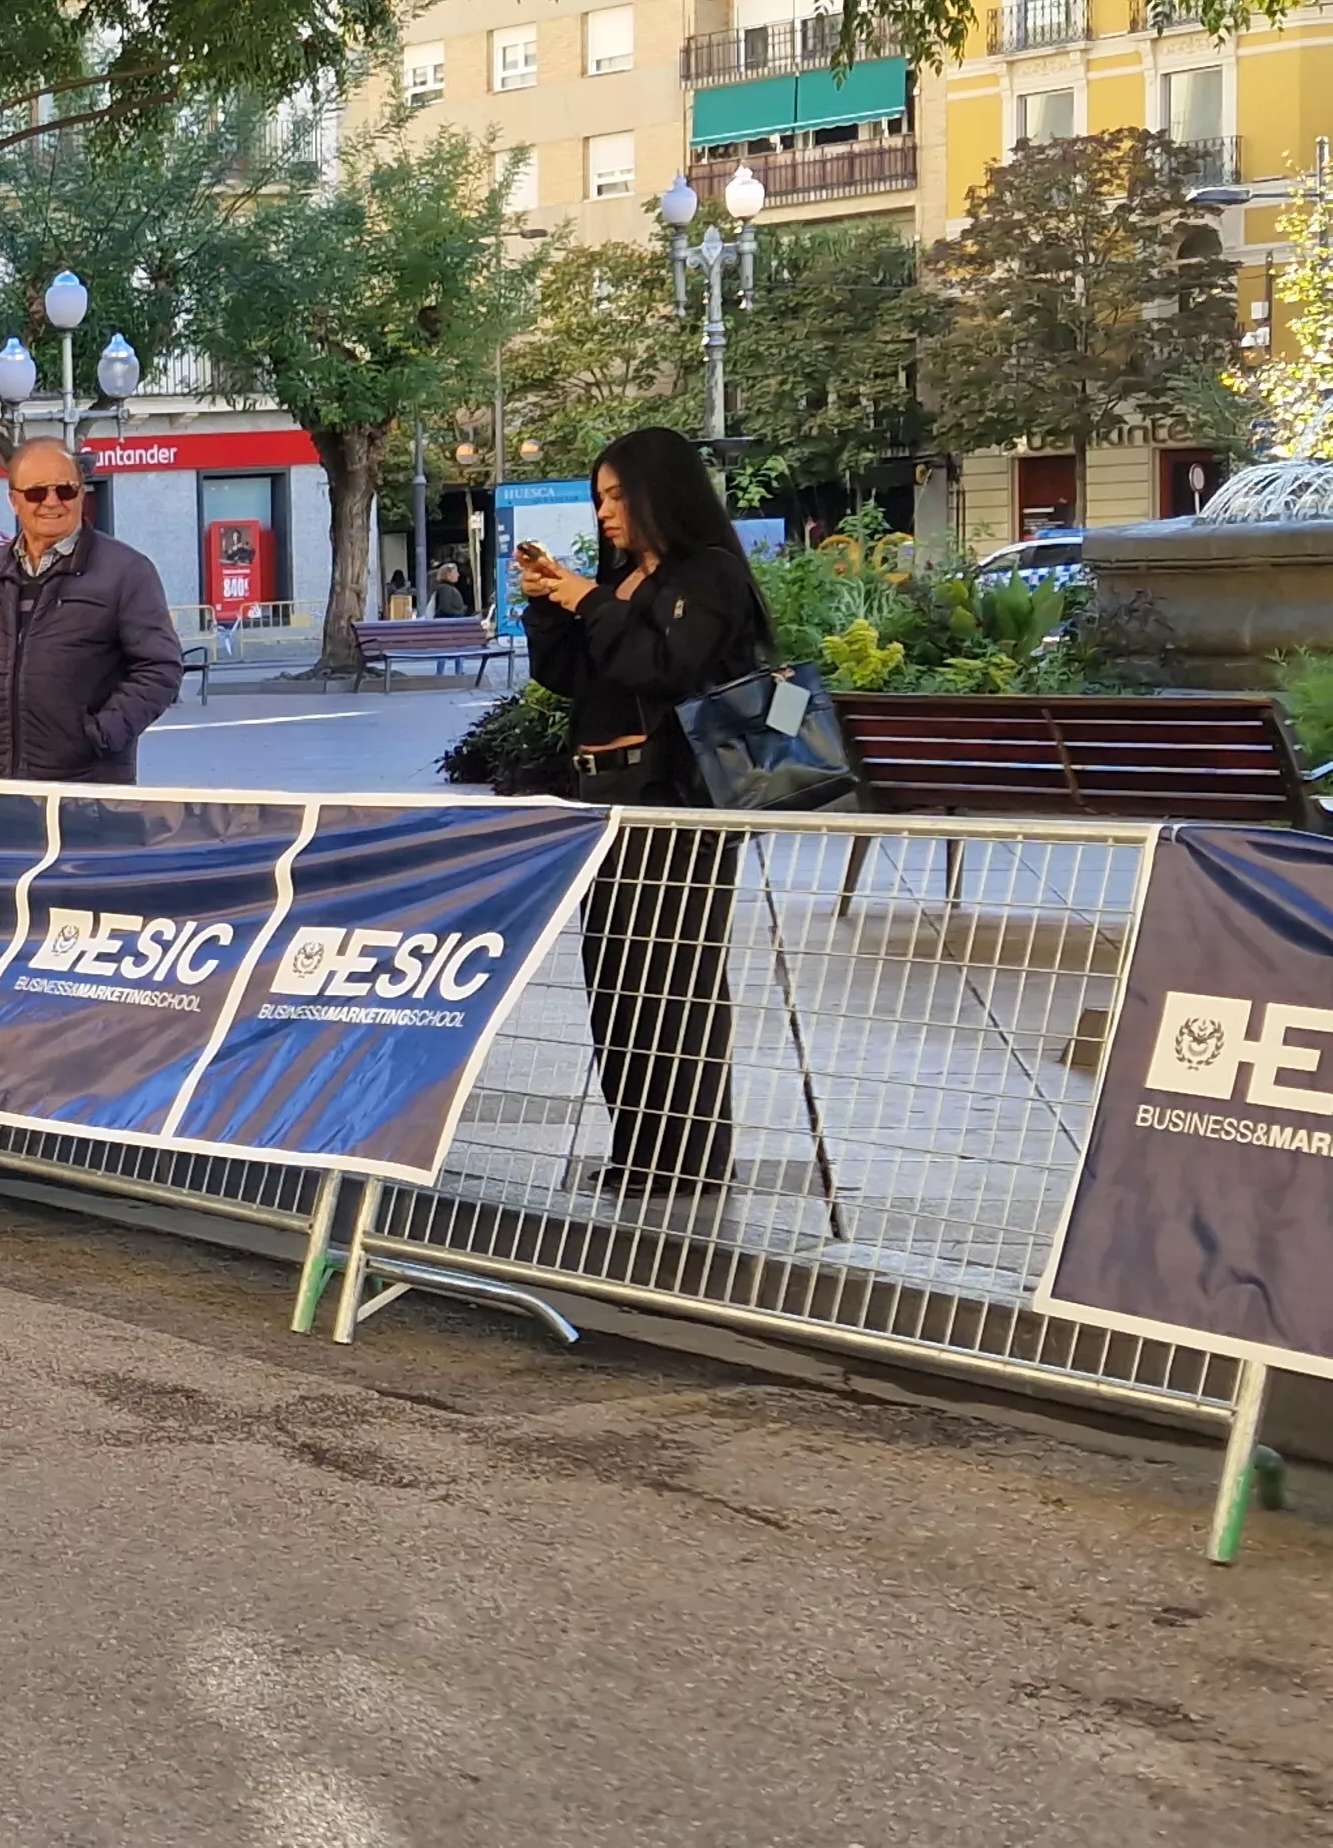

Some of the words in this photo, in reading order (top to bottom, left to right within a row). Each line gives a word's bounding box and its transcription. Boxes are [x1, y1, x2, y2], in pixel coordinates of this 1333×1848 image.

[81, 443, 177, 467] antander
[503, 487, 556, 501] HUESCA
[74, 912, 234, 986] ESIC
[323, 928, 505, 1001] ESIC
[1135, 1104, 1333, 1158] BUSINESS&MAR
